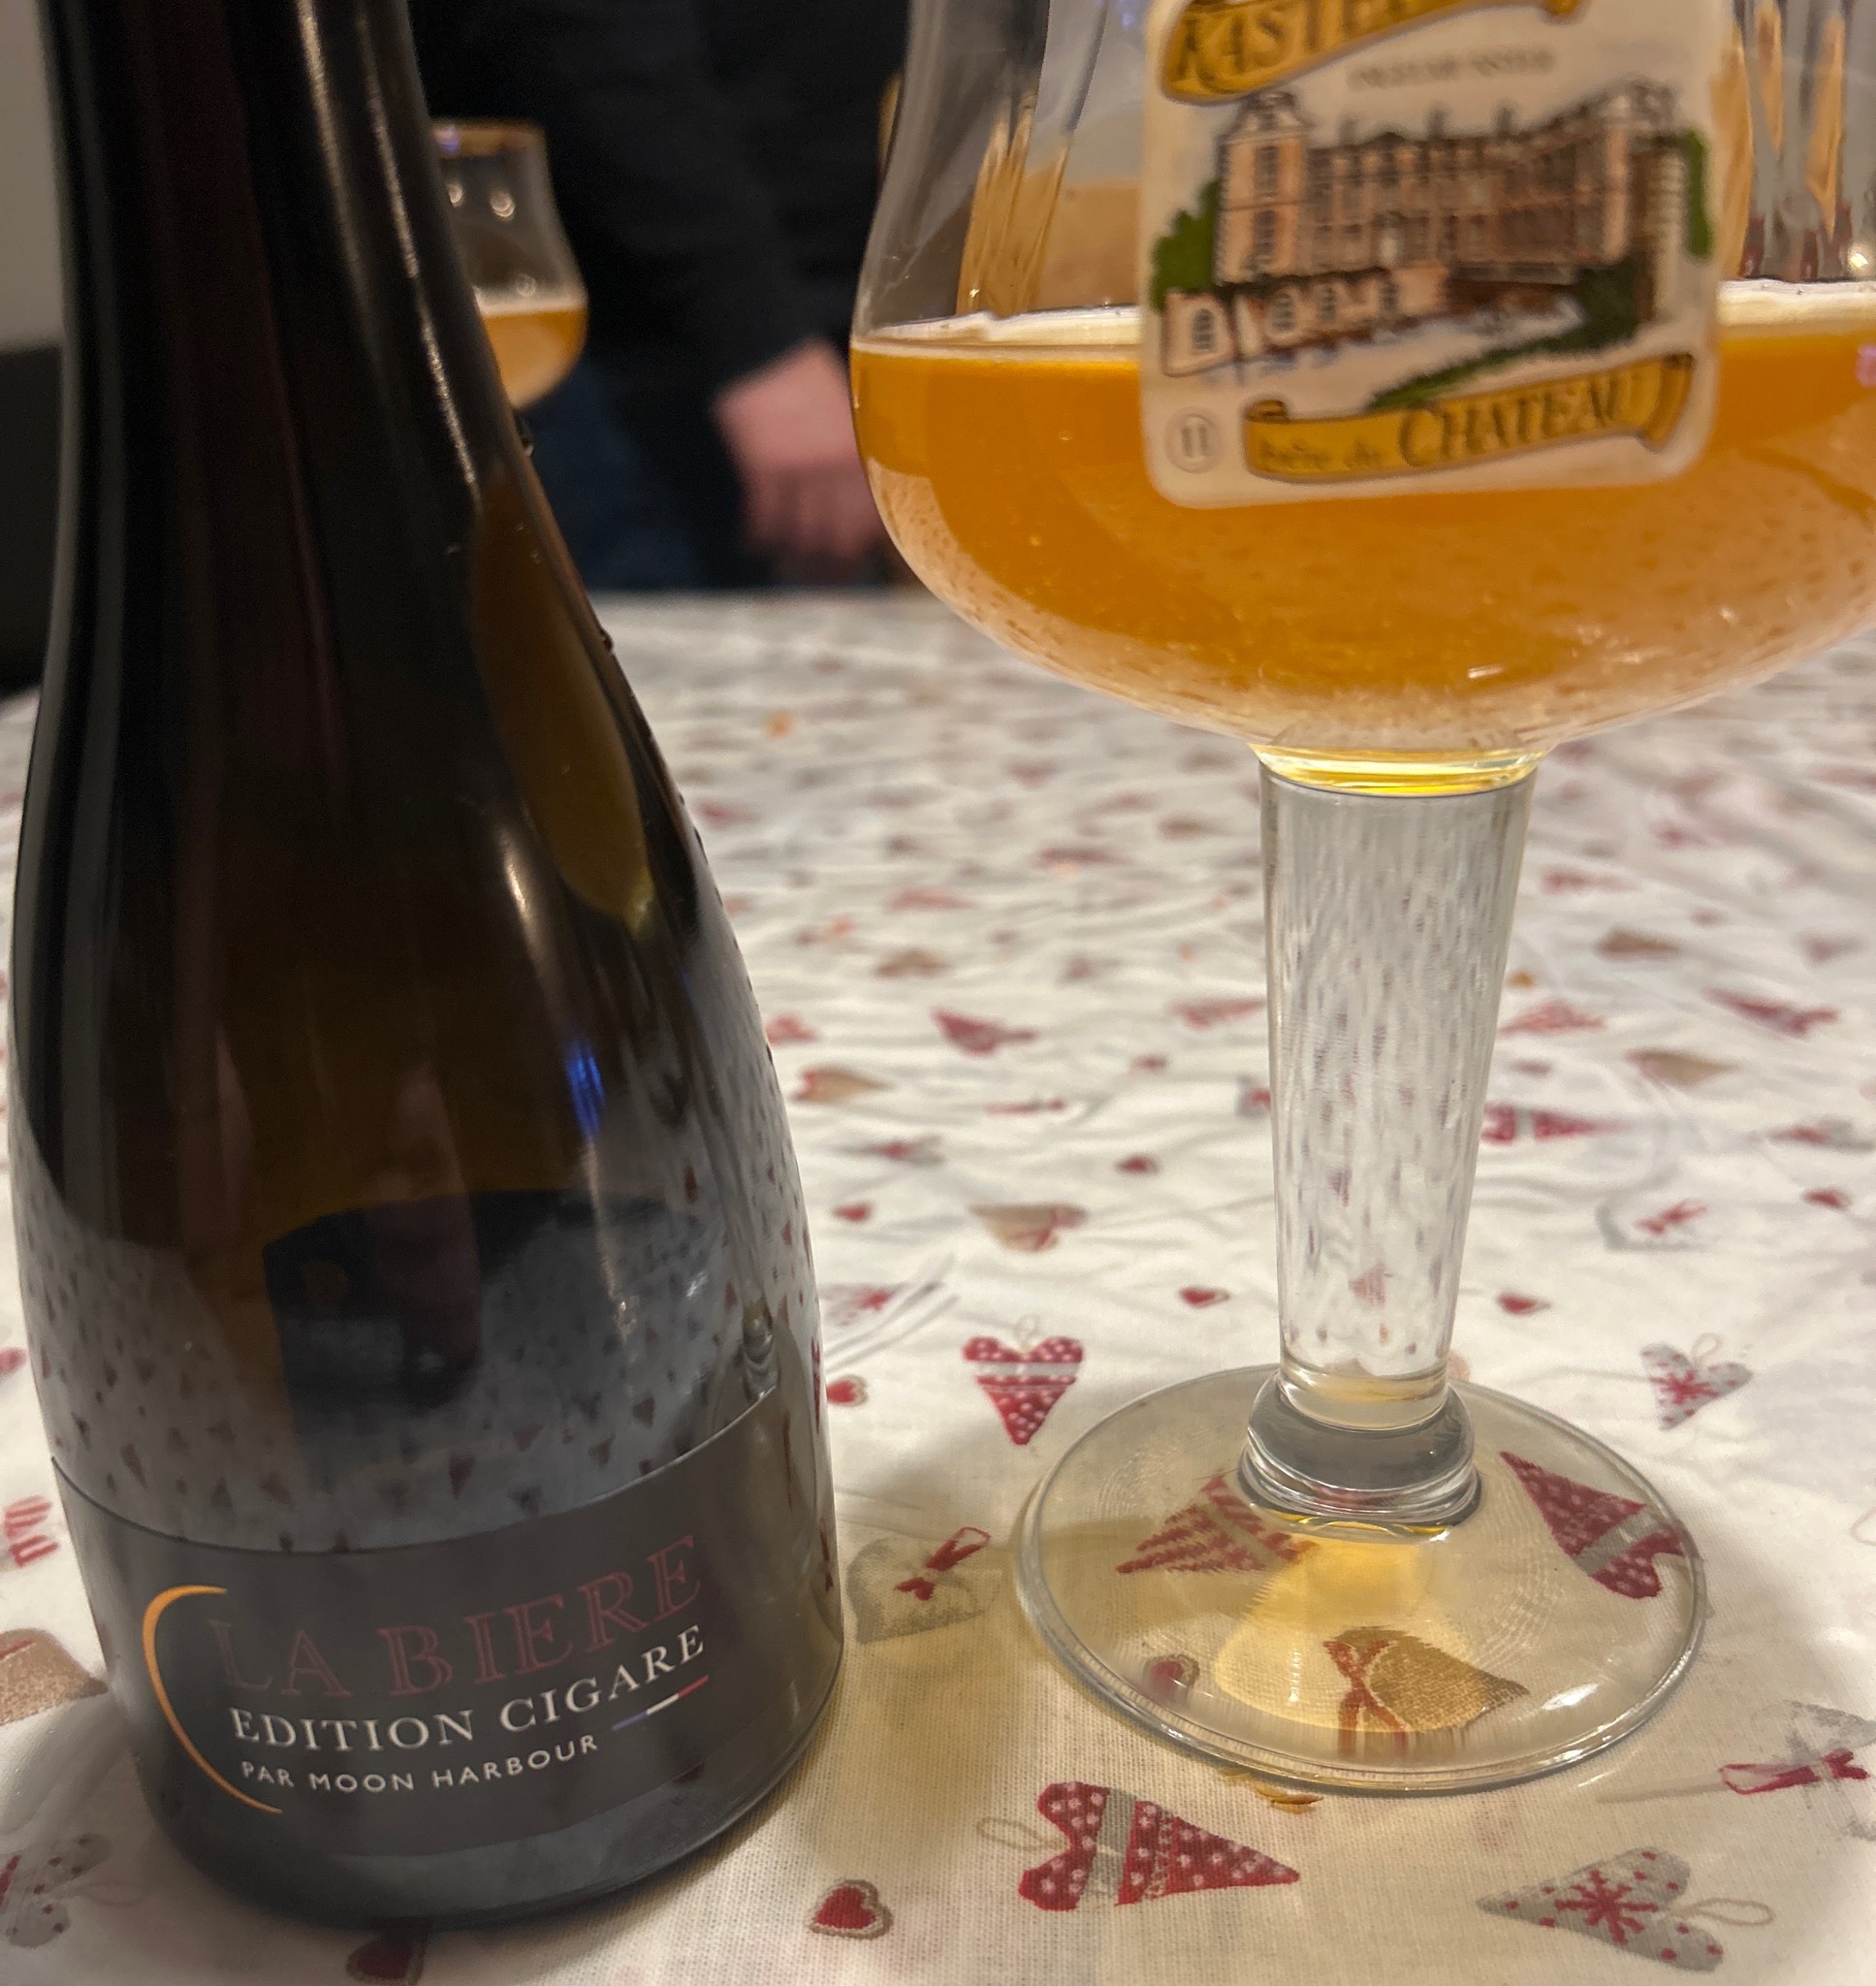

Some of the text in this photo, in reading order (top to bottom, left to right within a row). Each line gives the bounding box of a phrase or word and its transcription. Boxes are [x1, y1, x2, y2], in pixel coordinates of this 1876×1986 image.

[207, 1534, 704, 1698] LA BIERE
[227, 1624, 705, 1752] EDITION CIGARE
[240, 1733, 599, 1793] PAR MOON HARBOUR
